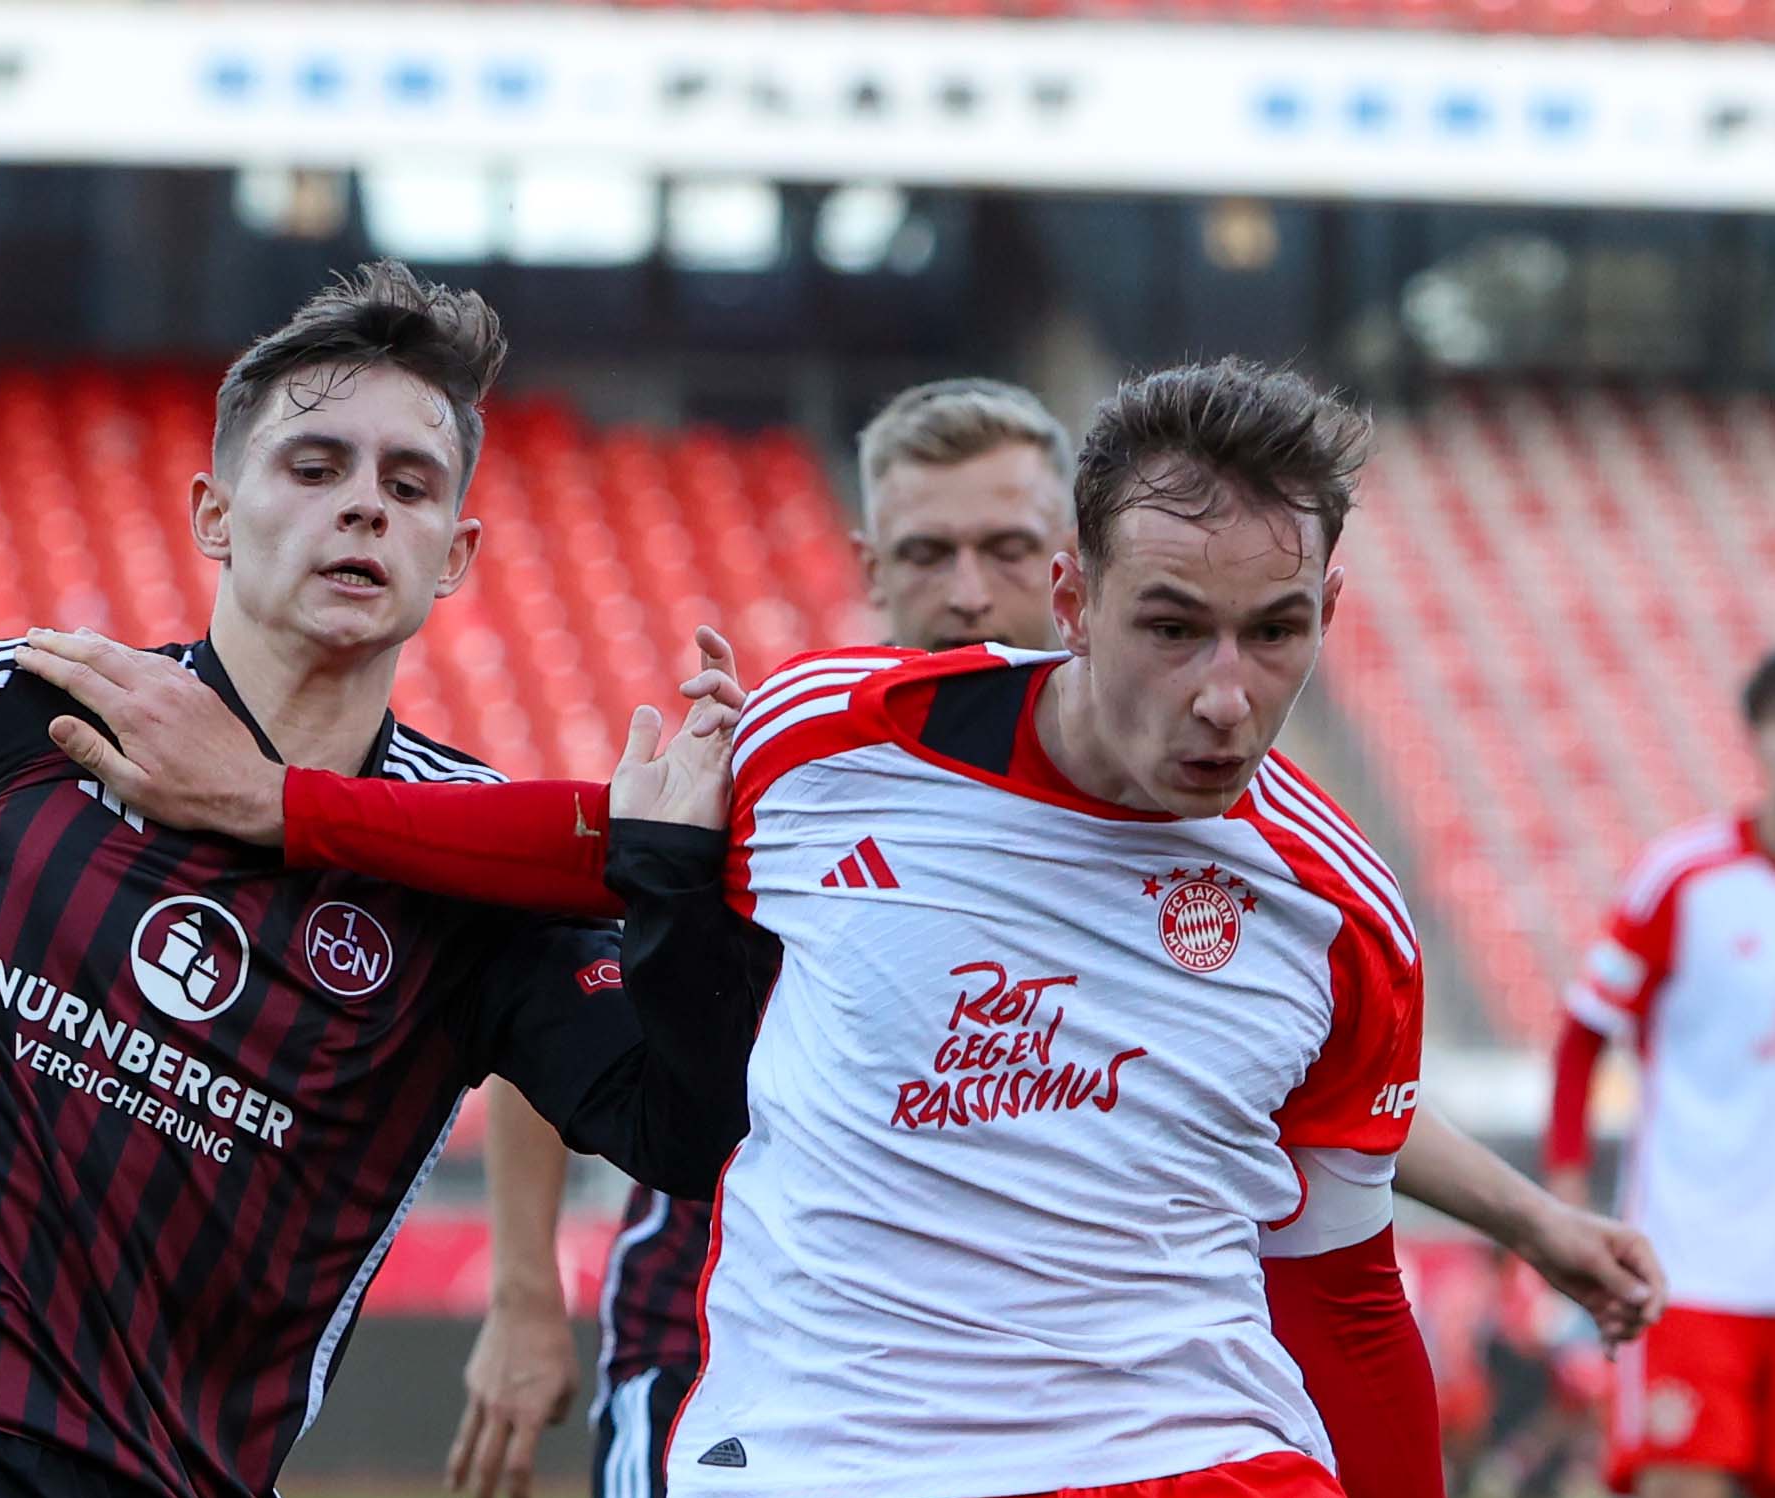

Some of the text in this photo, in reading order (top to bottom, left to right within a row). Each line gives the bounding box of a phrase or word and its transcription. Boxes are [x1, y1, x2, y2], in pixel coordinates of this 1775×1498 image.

[1166, 886, 1234, 924] FC BAYERN
[311, 926, 381, 982] FCN
[934, 1006, 1064, 1073] GEGEN
[15, 1032, 234, 1164] VERSICHERUNG
[891, 1047, 1148, 1130] RASSISMUS
